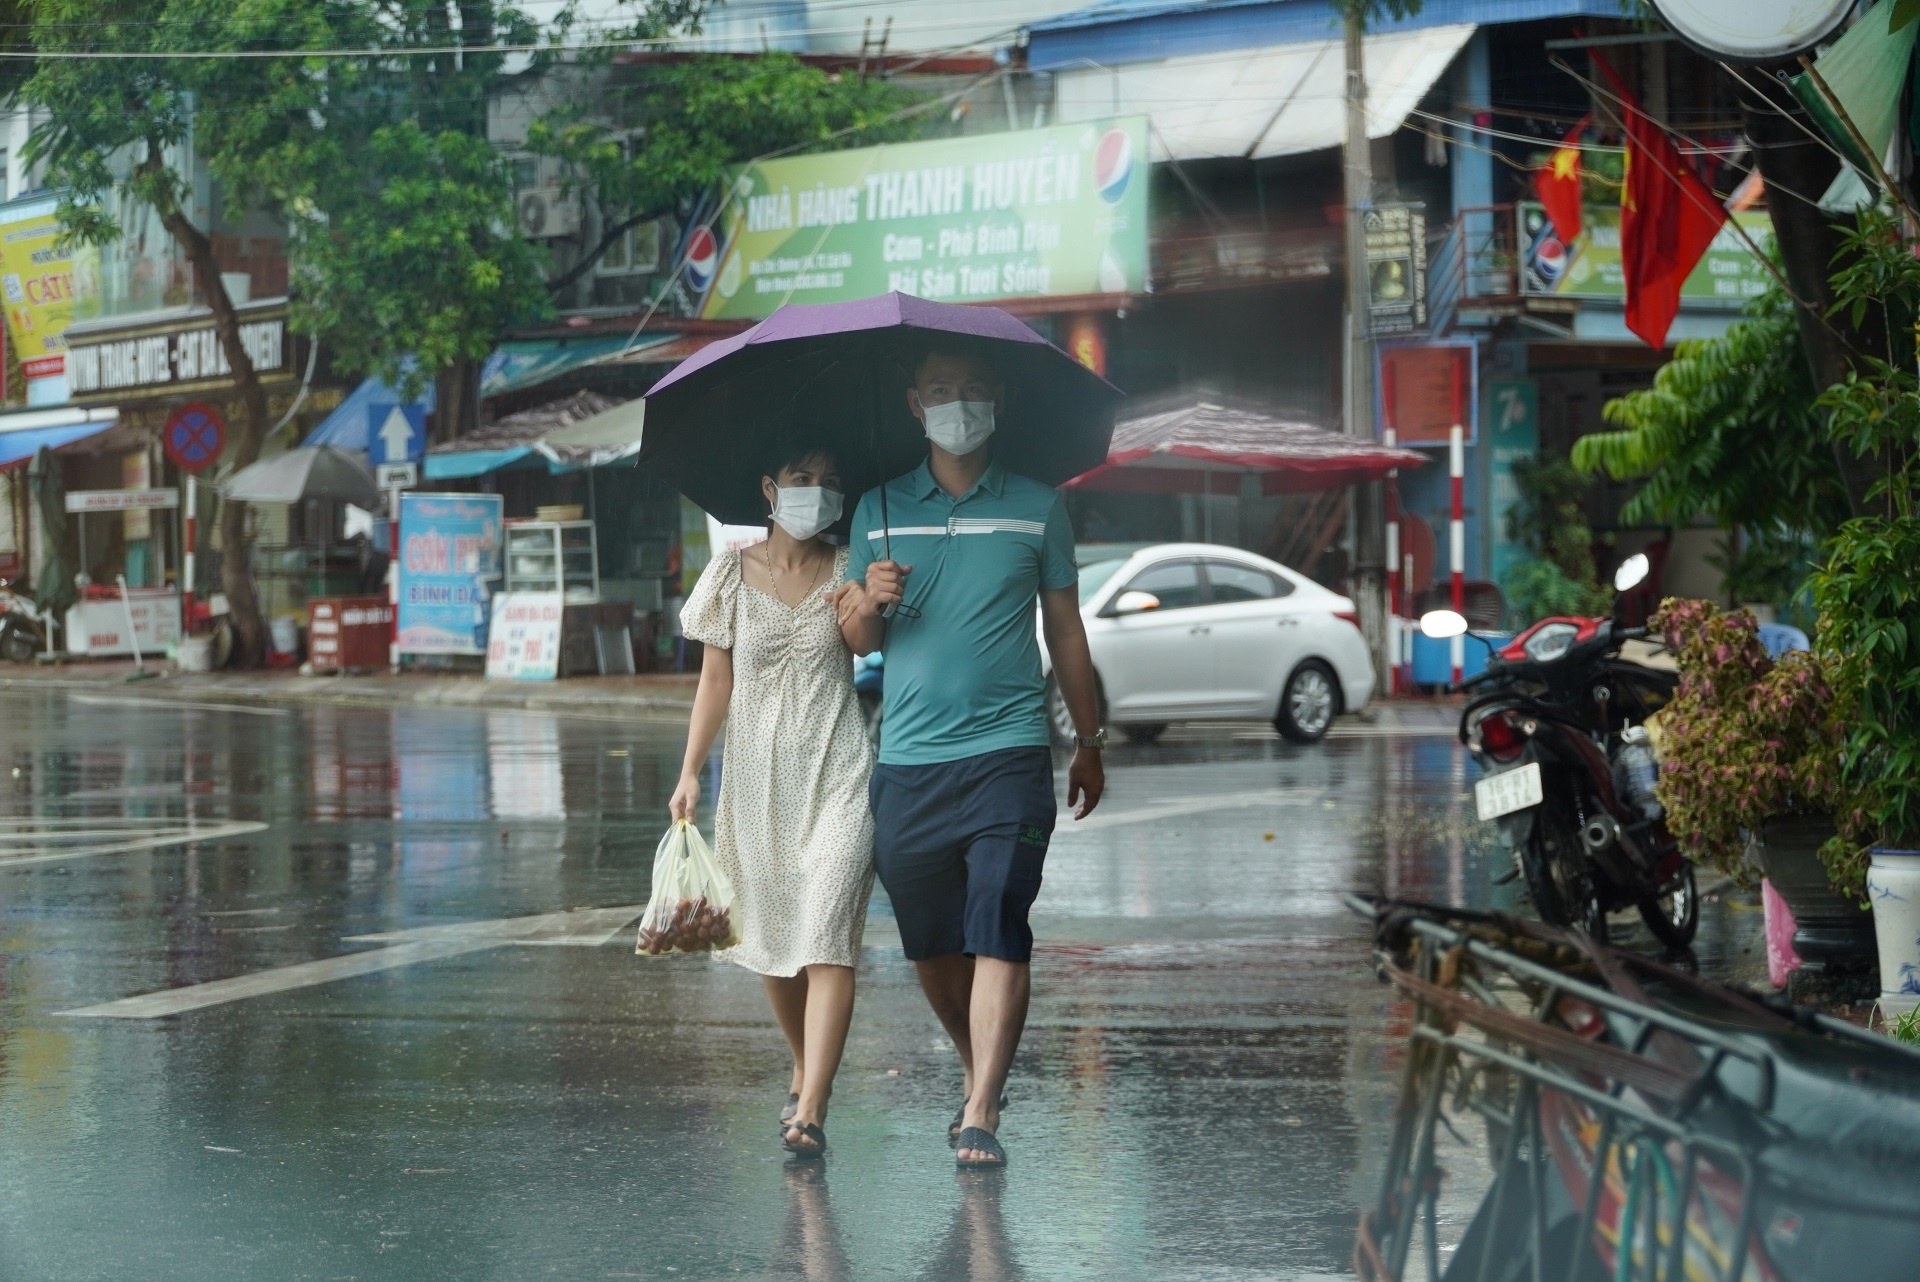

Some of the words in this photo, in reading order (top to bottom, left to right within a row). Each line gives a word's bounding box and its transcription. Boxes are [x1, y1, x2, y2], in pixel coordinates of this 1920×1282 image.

[747, 184, 793, 233] NHÀ
[797, 181, 860, 229] HÀNG
[864, 163, 965, 222] THANH
